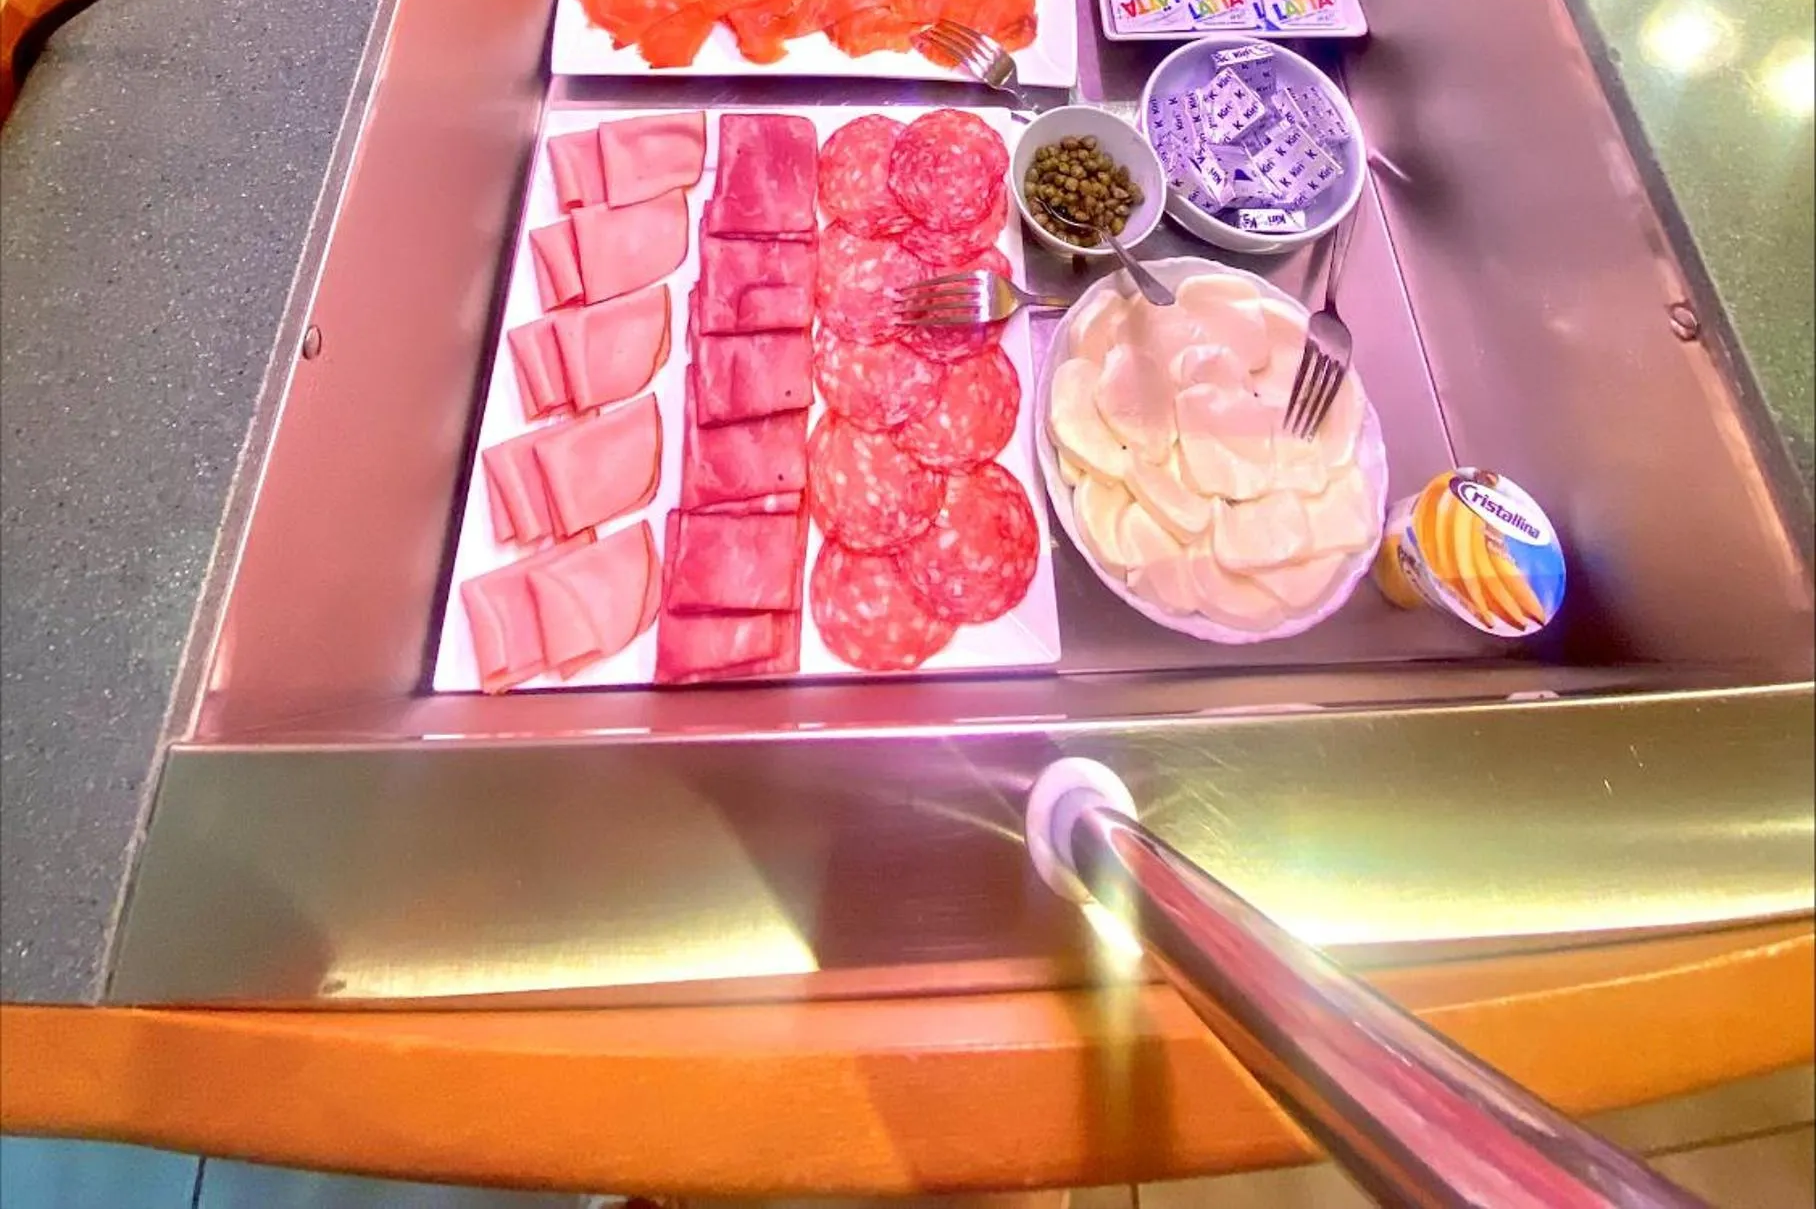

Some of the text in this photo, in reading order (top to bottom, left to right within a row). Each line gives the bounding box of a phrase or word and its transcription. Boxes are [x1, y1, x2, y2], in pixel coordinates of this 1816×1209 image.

[1234, 89, 1245, 100] K
[1217, 100, 1233, 119] Kiri
[1243, 100, 1259, 119] Kiri
[1233, 120, 1244, 130] K
[1285, 132, 1301, 146] Kiri
[1275, 146, 1287, 157] K
[1305, 149, 1318, 160] K
[1280, 177, 1292, 188] K
[1307, 179, 1319, 190] K
[1460, 483, 1541, 541] Cristallina
